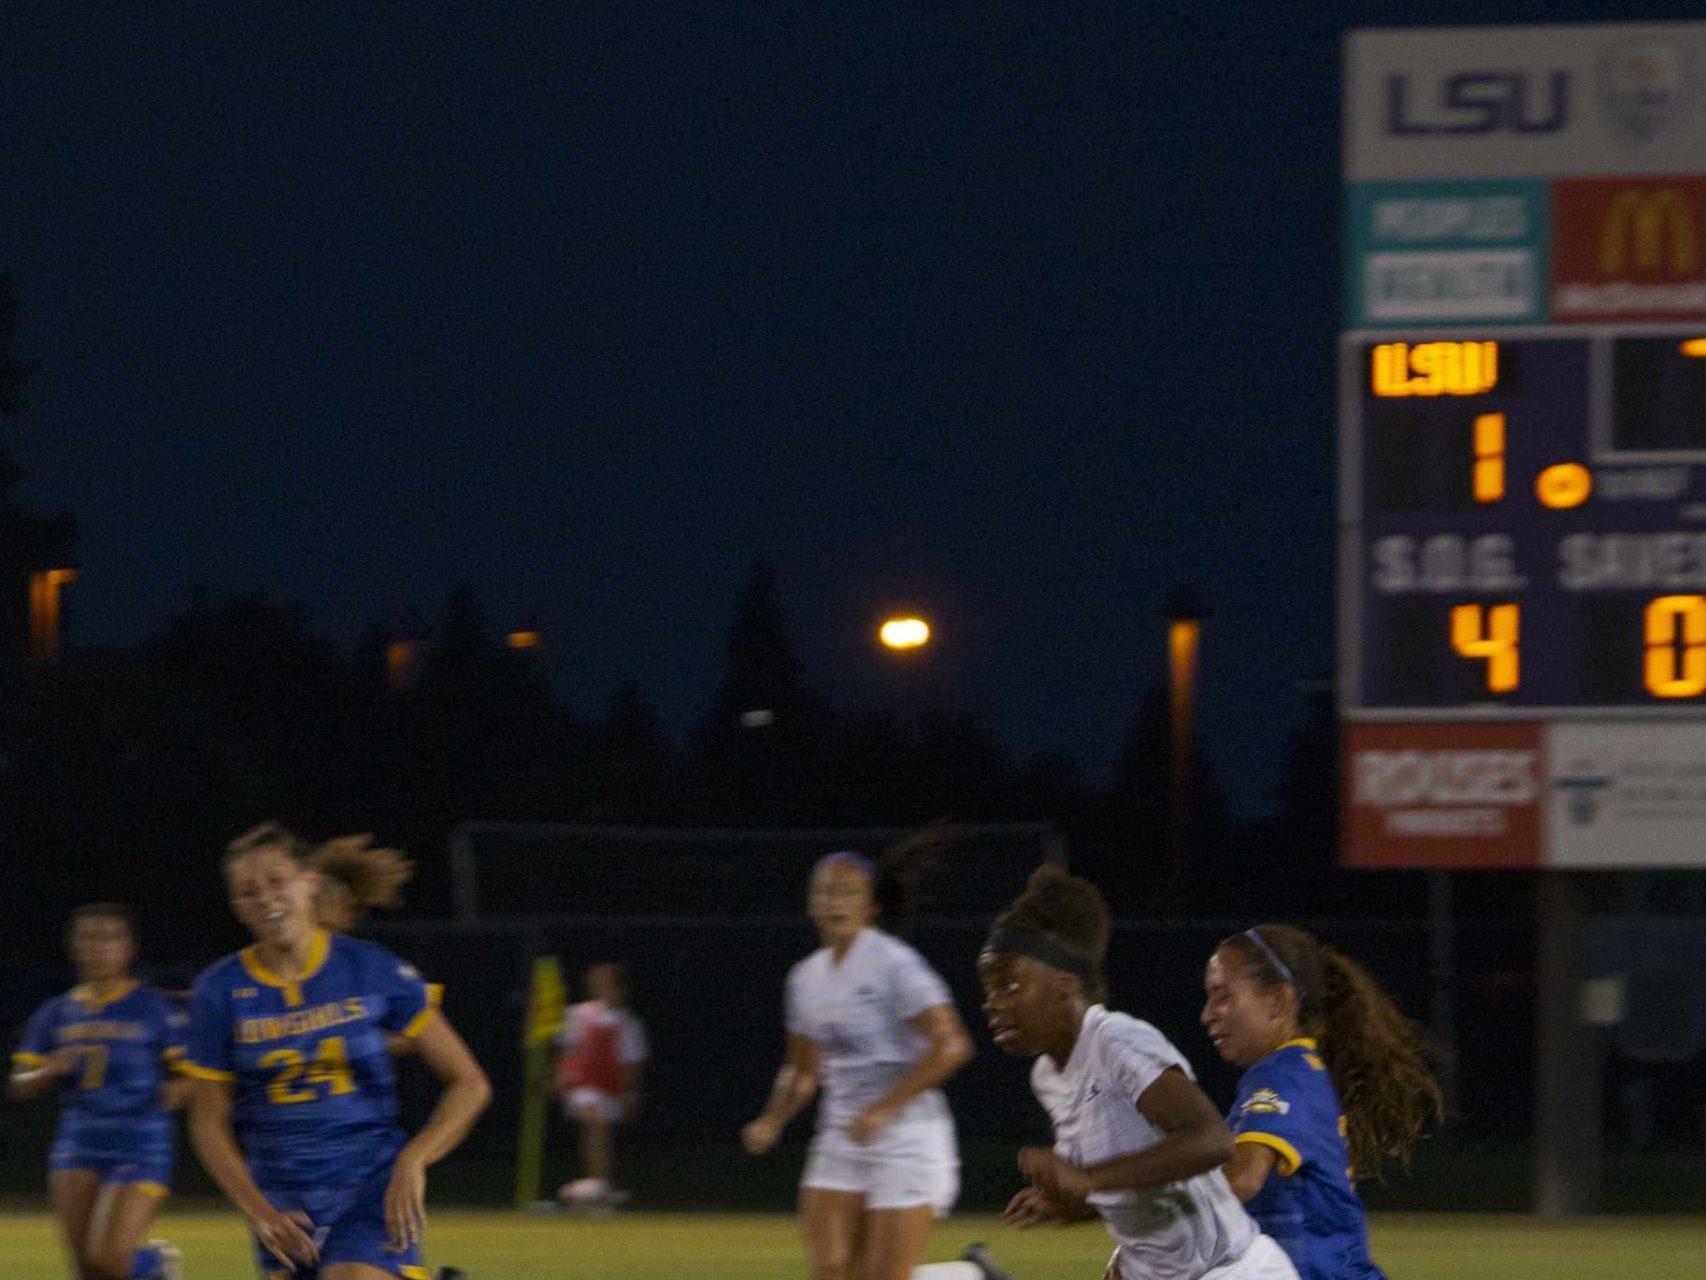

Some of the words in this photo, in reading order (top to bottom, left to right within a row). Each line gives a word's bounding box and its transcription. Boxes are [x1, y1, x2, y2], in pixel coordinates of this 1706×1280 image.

[1384, 70, 1568, 138] LSU
[1371, 339, 1499, 398] LSU
[1472, 411, 1507, 504] 1
[1450, 602, 1520, 693] 4
[1642, 593, 1706, 698] 0
[260, 1036, 359, 1105] 24
